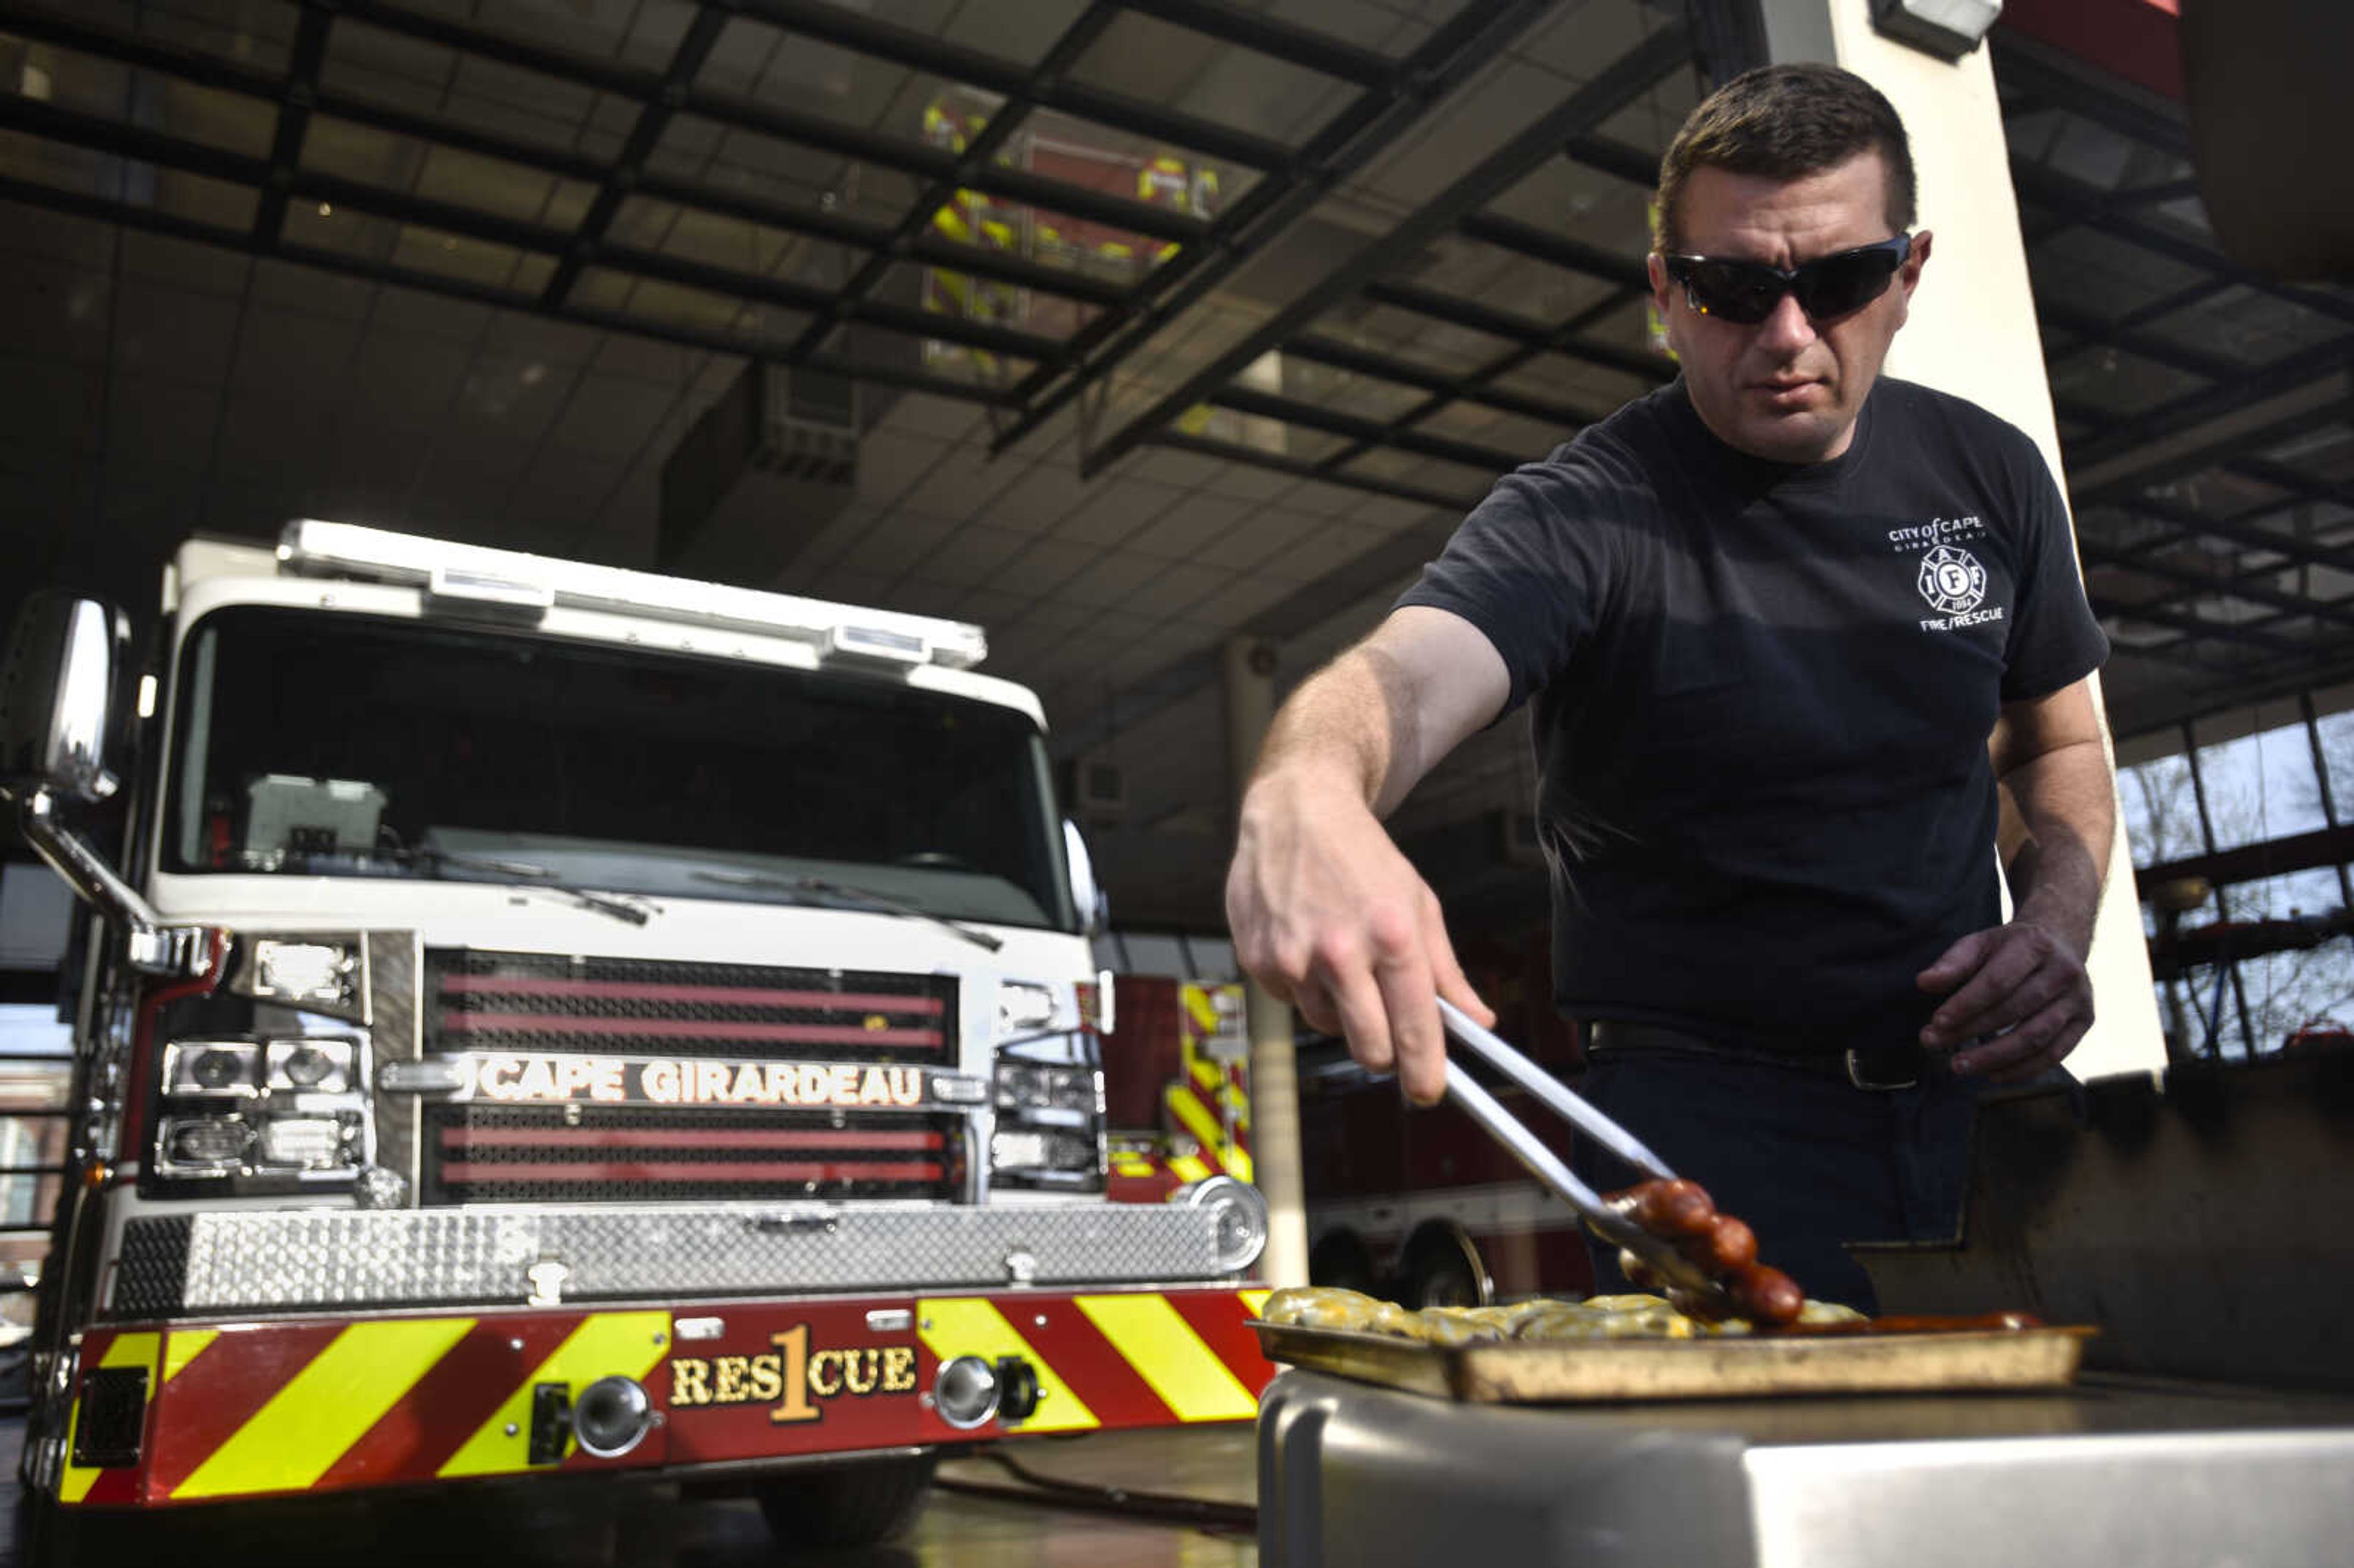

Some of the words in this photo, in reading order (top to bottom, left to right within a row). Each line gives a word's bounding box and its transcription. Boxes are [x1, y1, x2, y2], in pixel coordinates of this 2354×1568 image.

[1889, 527, 1919, 541] CITY
[1941, 516, 1983, 533] CAPE
[1945, 569, 1959, 589] F
[1919, 607, 2003, 631] FIRE/RESCUE
[481, 1059, 626, 1102] CAPE
[641, 1059, 922, 1106] GIRARDEAU
